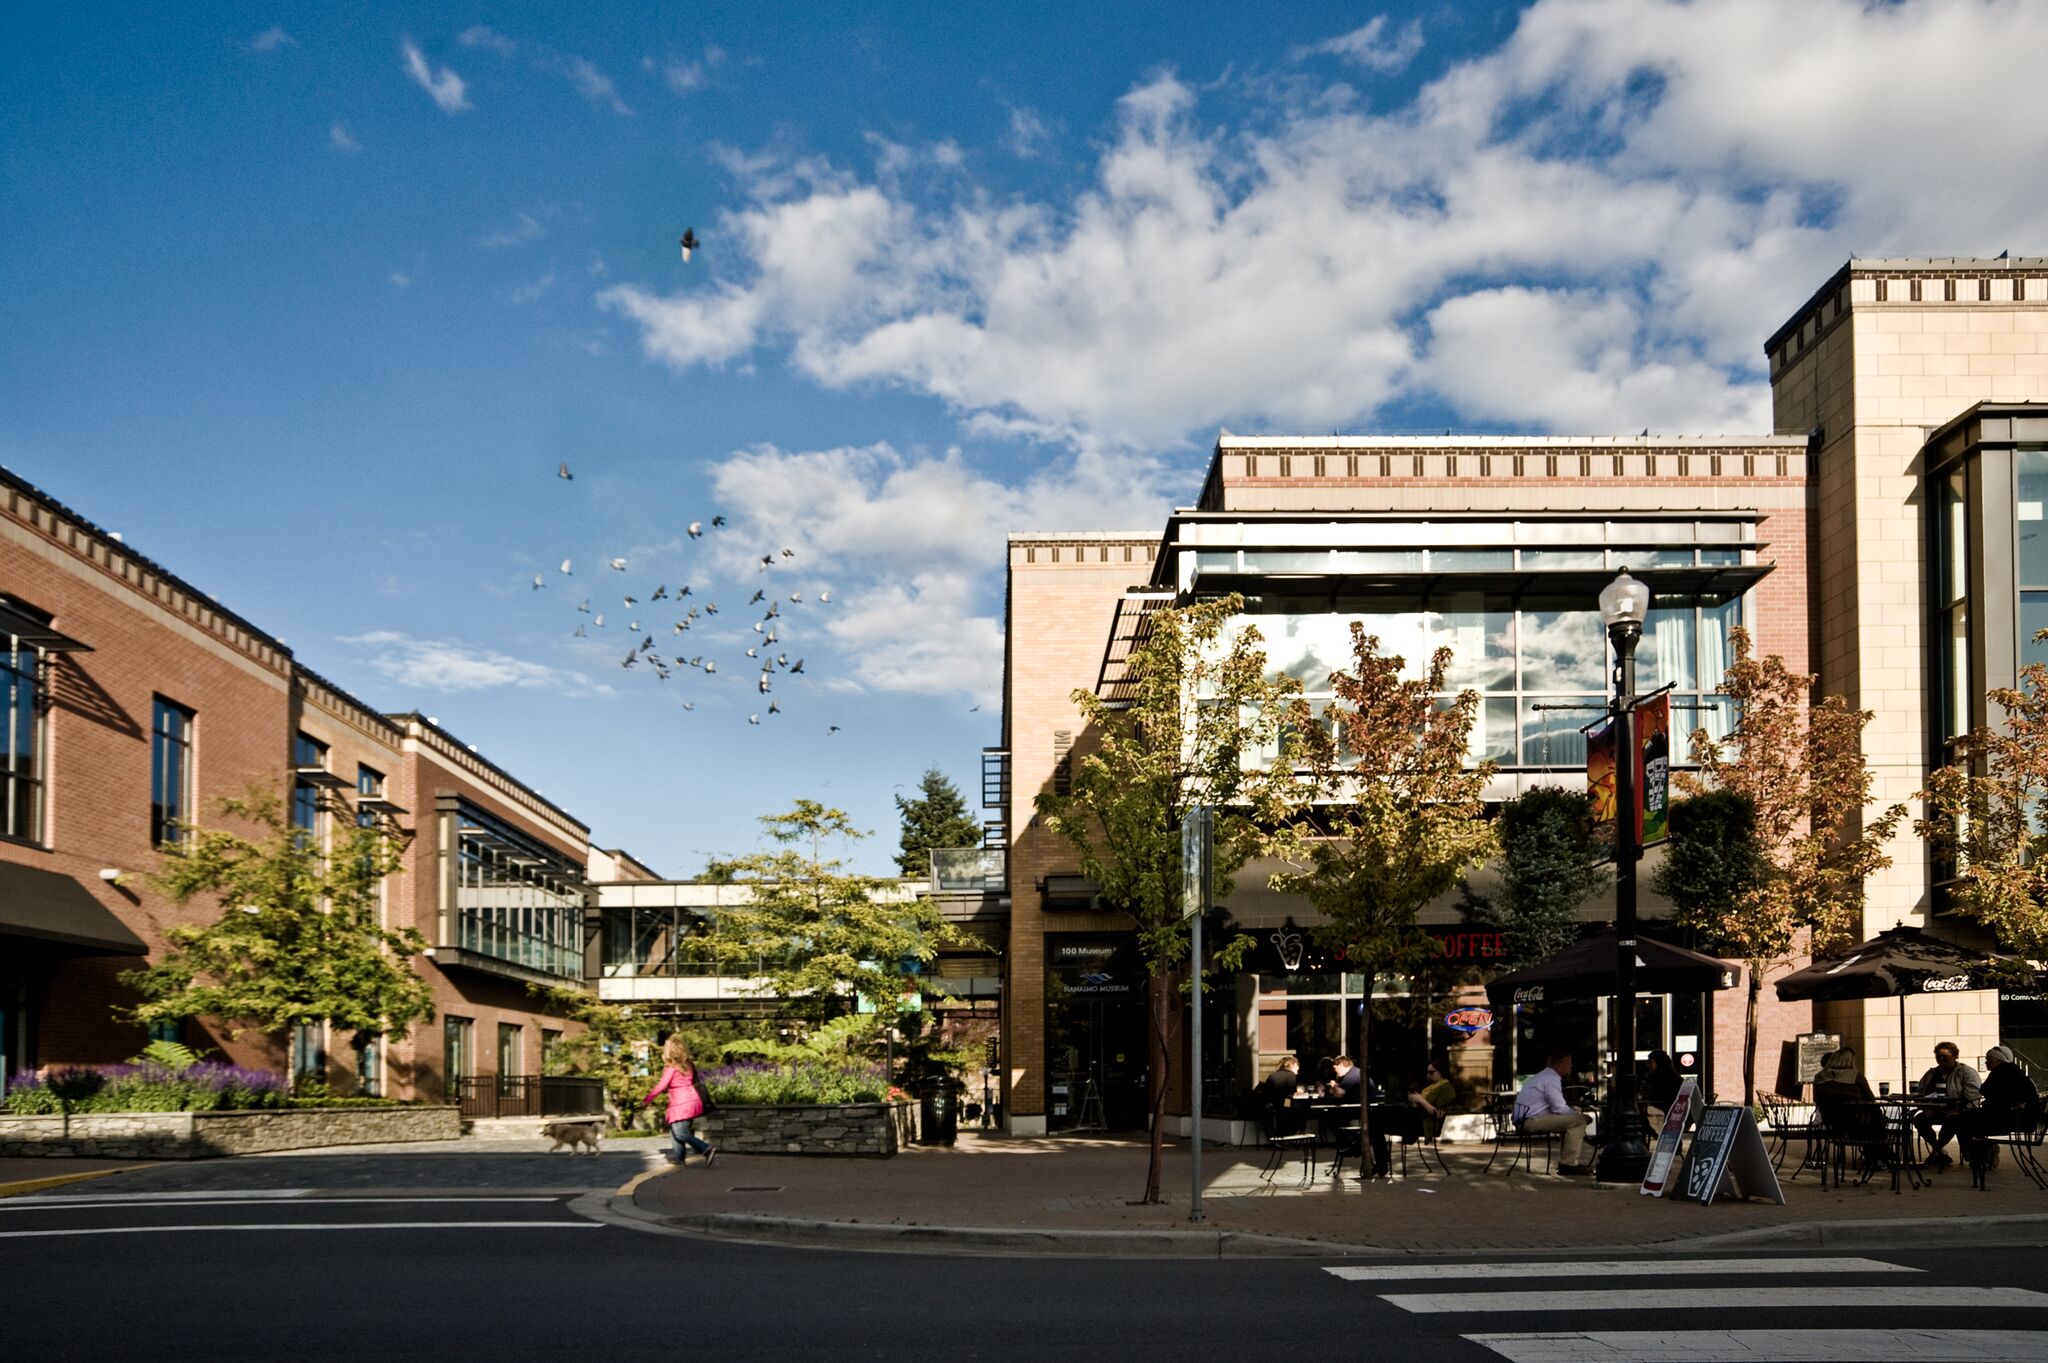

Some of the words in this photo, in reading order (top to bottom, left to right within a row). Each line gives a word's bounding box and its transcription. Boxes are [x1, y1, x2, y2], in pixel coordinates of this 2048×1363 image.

[1061, 947, 1077, 955] 100
[1078, 947, 1112, 955] Museum
[1099, 985, 1130, 993] MUSEUM
[1447, 1012, 1493, 1026] OPEN
[1702, 1109, 1732, 1126] SERIOUS
[1697, 1125, 1727, 1142] COFFEE
